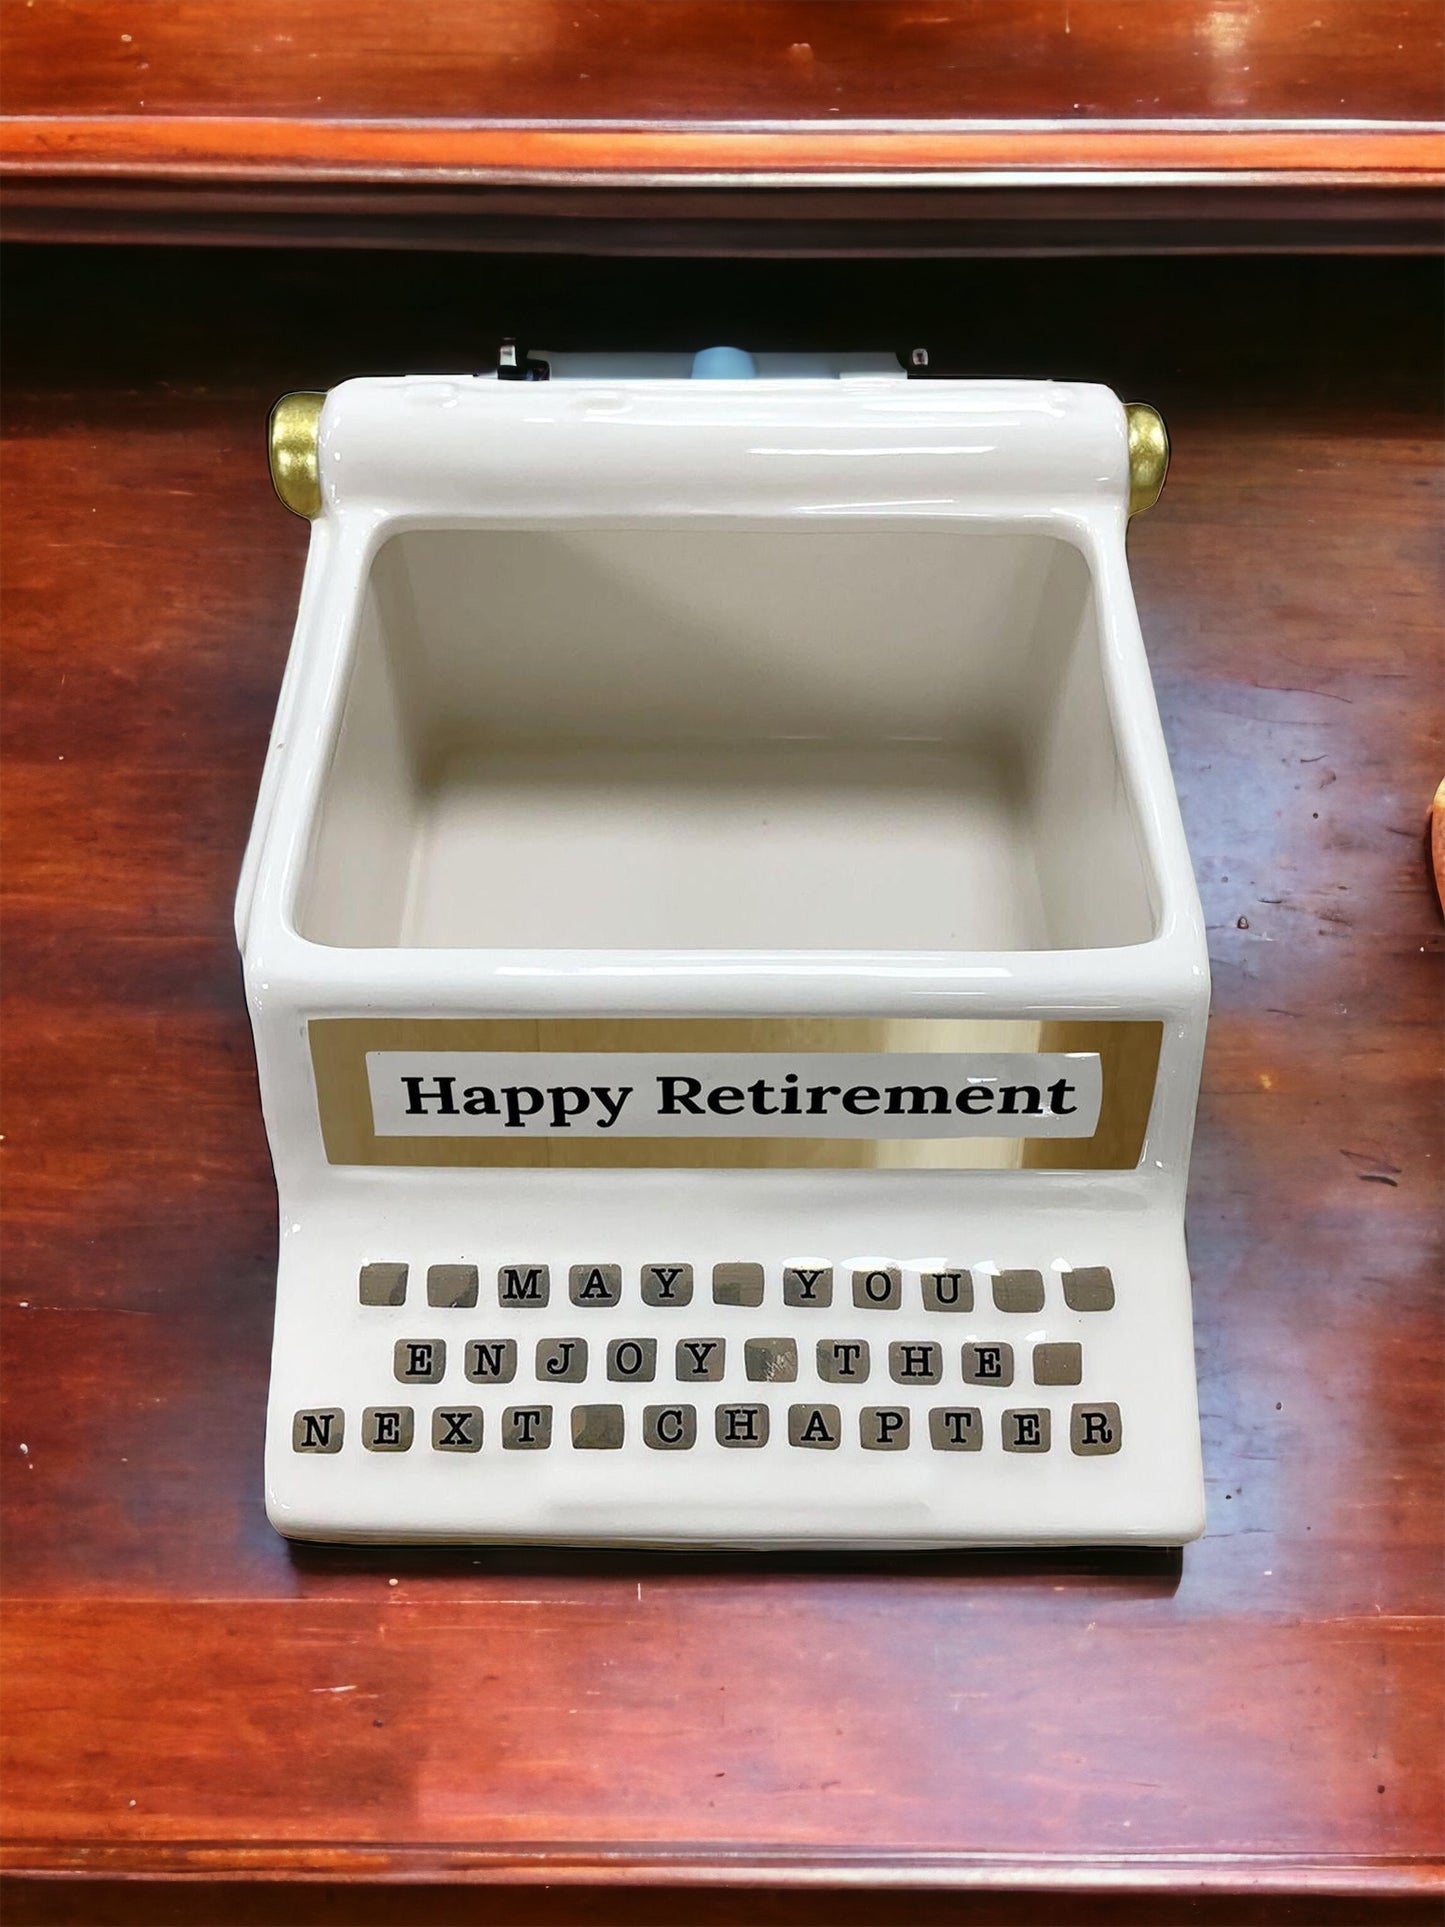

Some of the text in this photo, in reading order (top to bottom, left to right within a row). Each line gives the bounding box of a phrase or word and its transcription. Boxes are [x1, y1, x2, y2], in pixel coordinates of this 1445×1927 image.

[400, 1073, 1078, 1128] Happy Retirement
[502, 1268, 961, 1303] MAY YOU
[405, 1342, 1002, 1378] ENJOY THE
[300, 1408, 1113, 1448] NEXT CHAPTER
